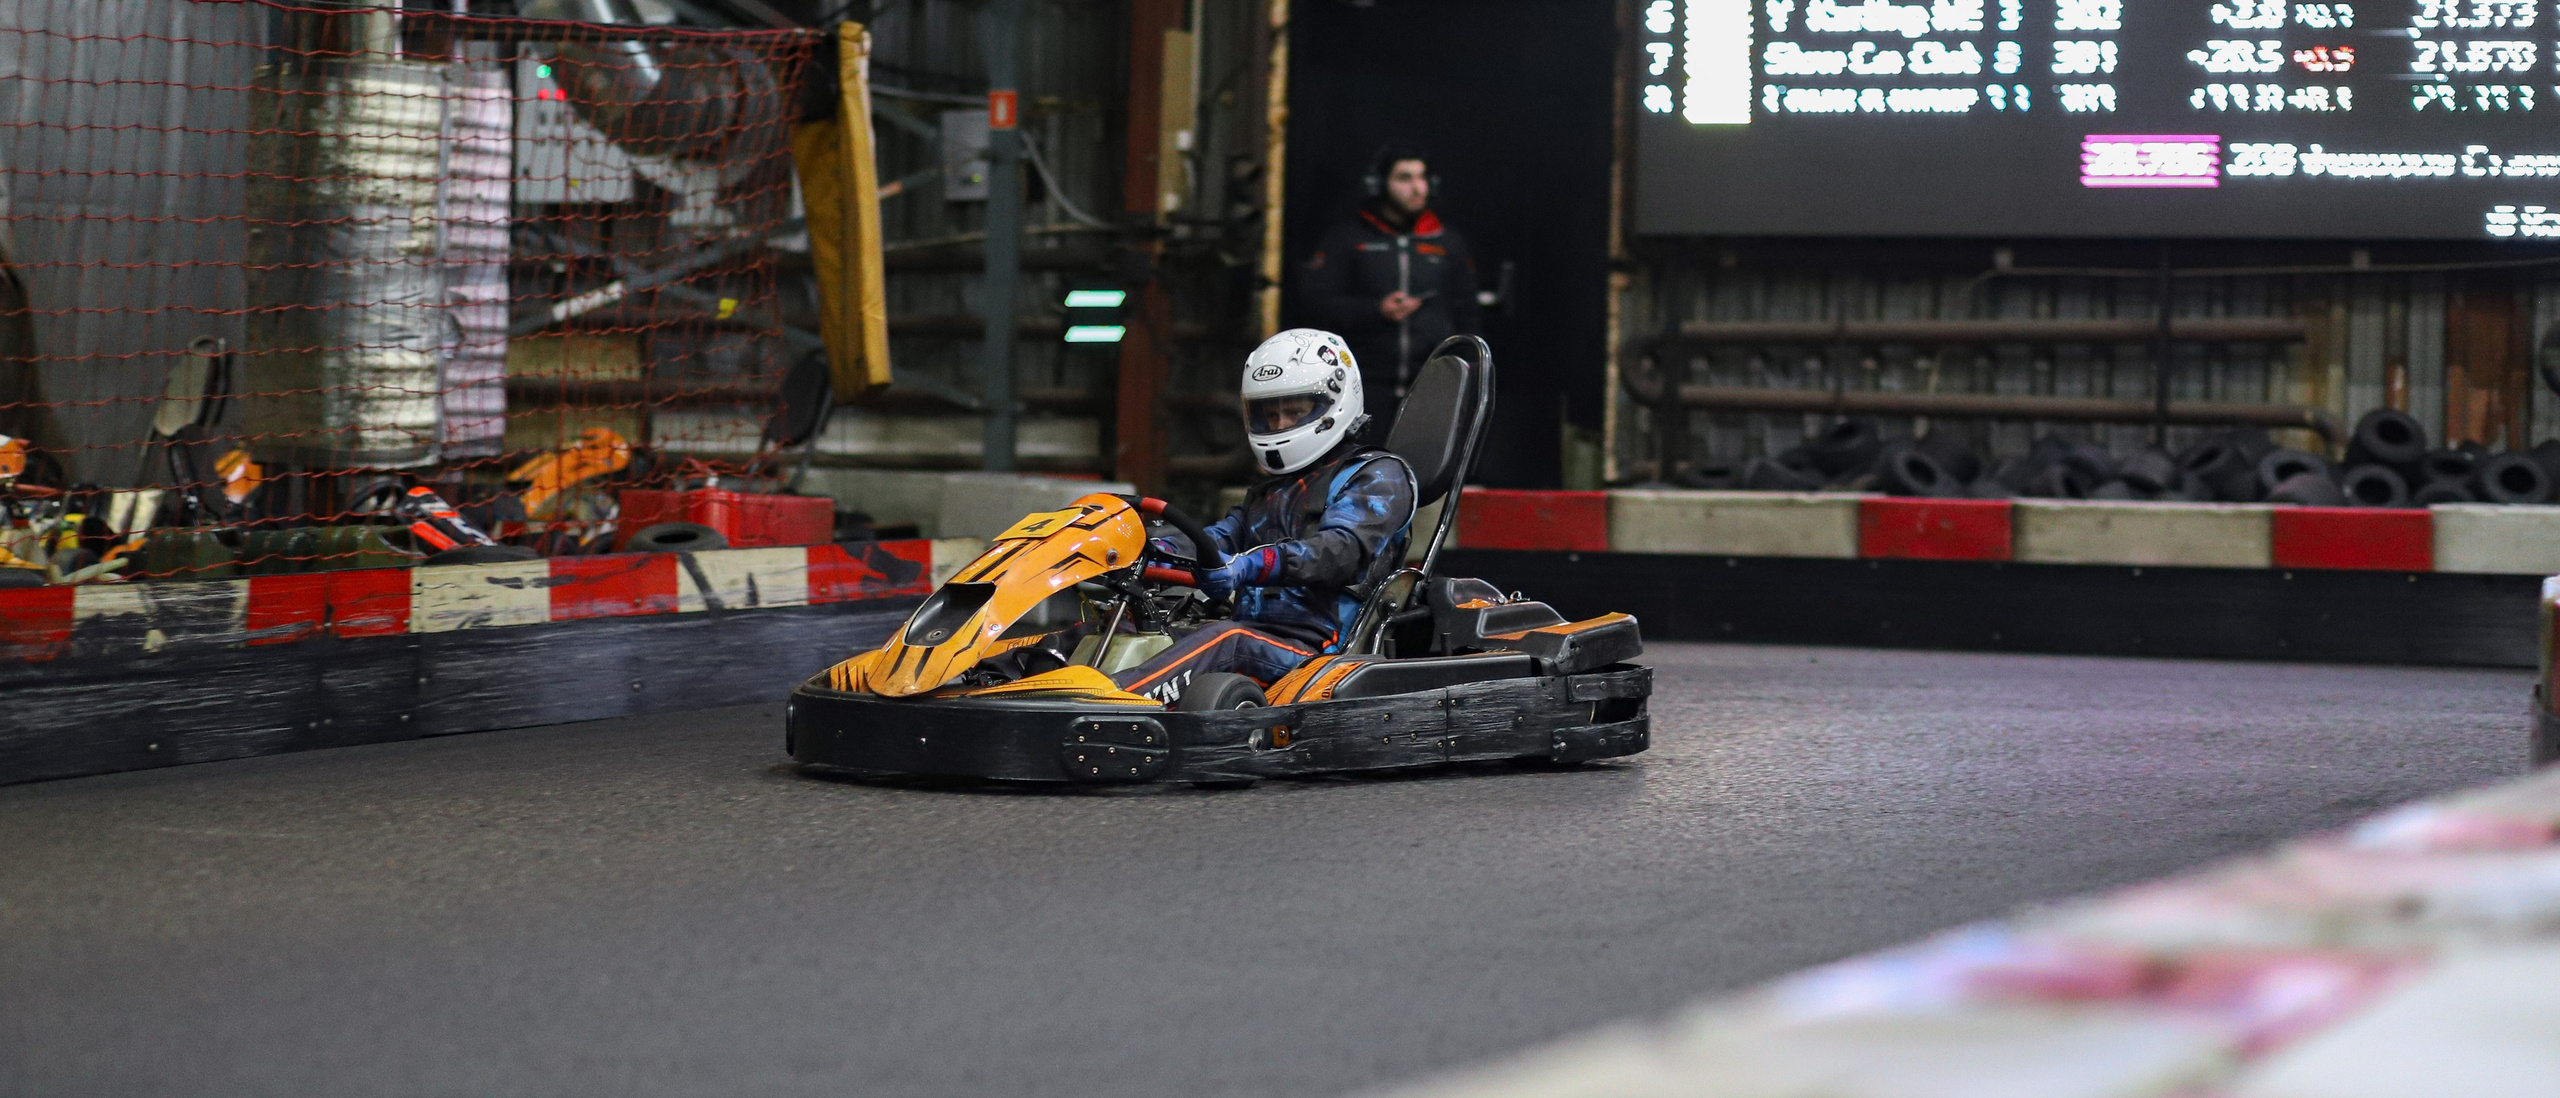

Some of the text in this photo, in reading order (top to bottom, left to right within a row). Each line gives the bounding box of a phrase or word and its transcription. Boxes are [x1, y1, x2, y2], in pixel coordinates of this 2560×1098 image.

[1645, 42, 1674, 75] 7
[1254, 366, 1280, 379] Arai
[1020, 518, 1056, 533] 4
